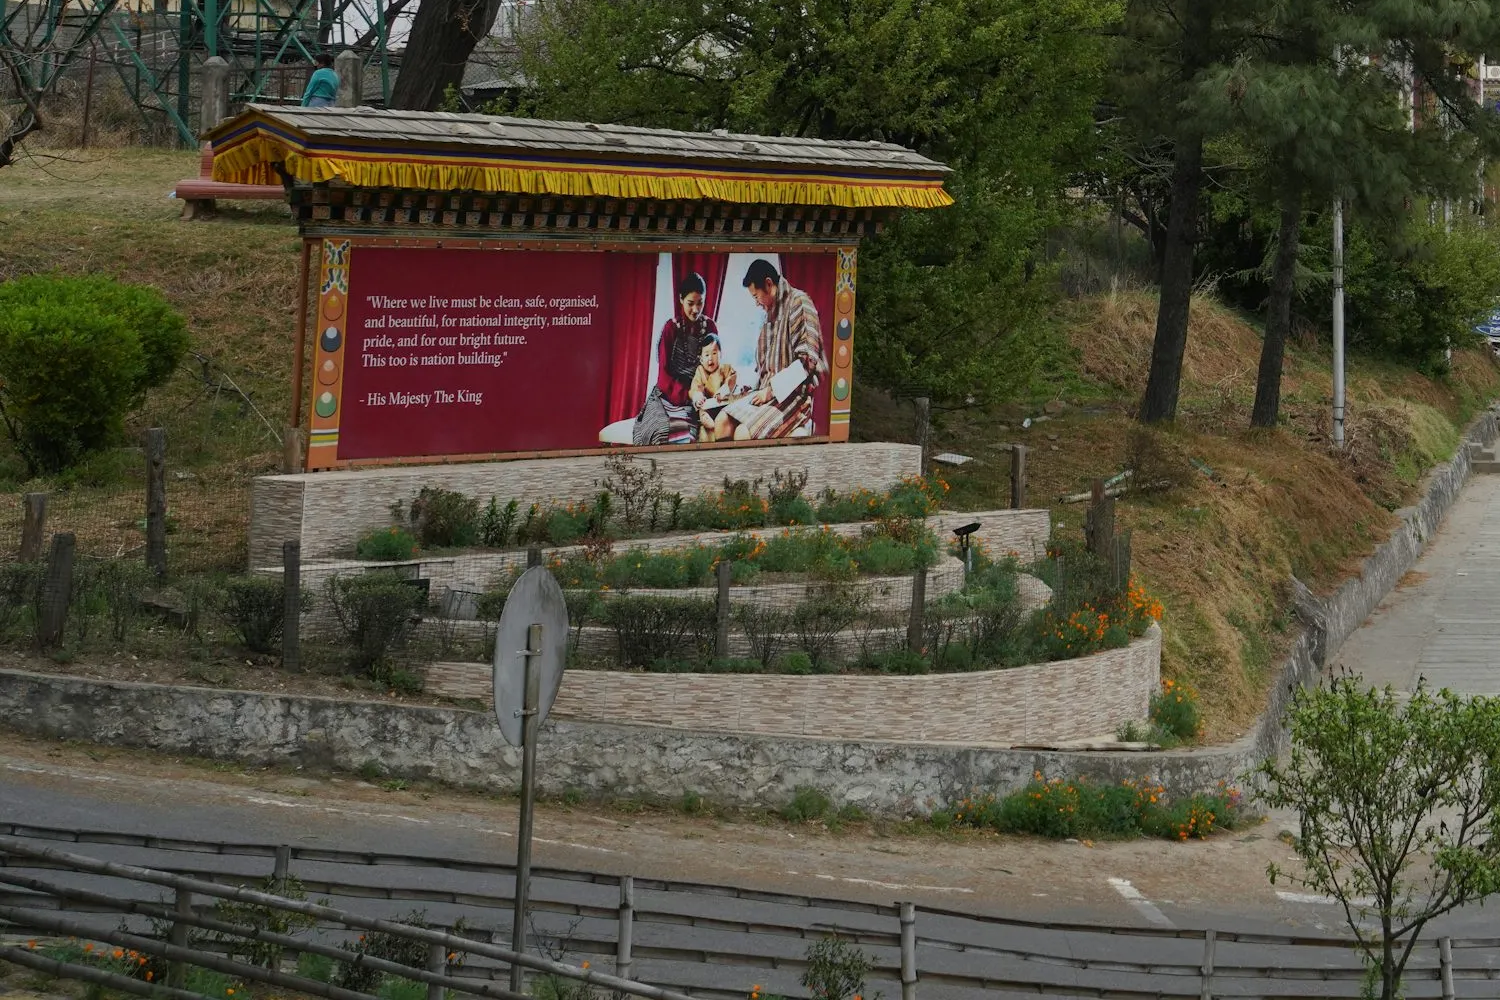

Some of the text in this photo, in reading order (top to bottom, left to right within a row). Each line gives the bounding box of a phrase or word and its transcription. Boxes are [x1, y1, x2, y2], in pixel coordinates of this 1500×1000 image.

[366, 294, 599, 311] "Where we live must be clean, safe, organised,
[364, 313, 592, 330] and beautiful, for national integrity, national
[363, 332, 527, 352] pride, and for our bright future.
[361, 352, 508, 367] This too is nation building."
[367, 392, 387, 406] His
[389, 391, 432, 408] Majesty
[434, 390, 454, 404] The
[457, 389, 483, 406] King
